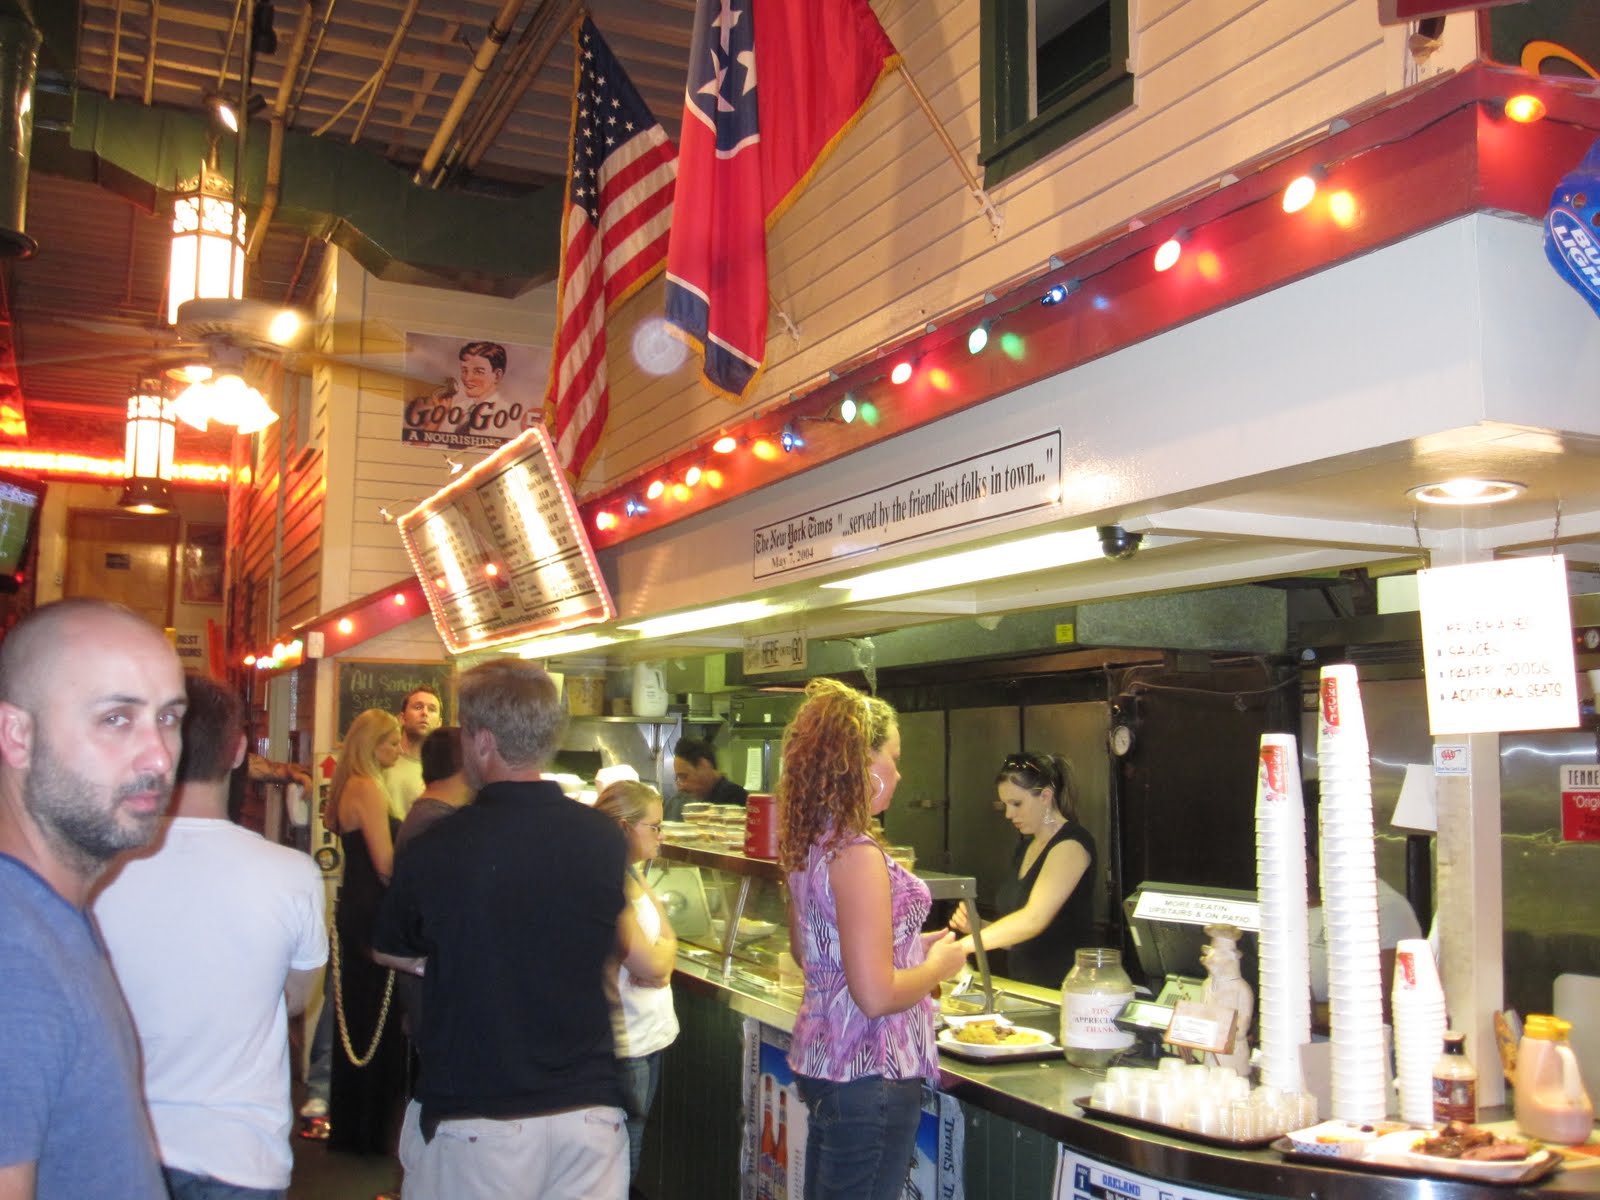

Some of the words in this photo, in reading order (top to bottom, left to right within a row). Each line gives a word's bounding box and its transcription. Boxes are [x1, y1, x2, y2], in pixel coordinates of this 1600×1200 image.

[1571, 229, 1600, 270] BU
[408, 430, 419, 441] A
[424, 432, 503, 447] NOURISHING
[755, 533, 769, 554] The
[770, 529, 787, 551] New
[787, 520, 807, 550] York
[808, 516, 833, 539] Times
[880, 501, 891, 534] by
[893, 496, 907, 523] the
[909, 481, 958, 519] friendliest
[961, 470, 987, 503] folks
[991, 465, 1002, 495] in
[771, 556, 787, 569] May
[797, 546, 814, 562] 2004
[1526, 682, 1563, 698] SEATS
[1148, 906, 1193, 917] UPSTAIRS
[1204, 912, 1219, 920] ON
[1221, 914, 1250, 924] PATIO
[1193, 902, 1229, 912] SEATIN
[1102, 1173, 1142, 1197] OAKLAND
